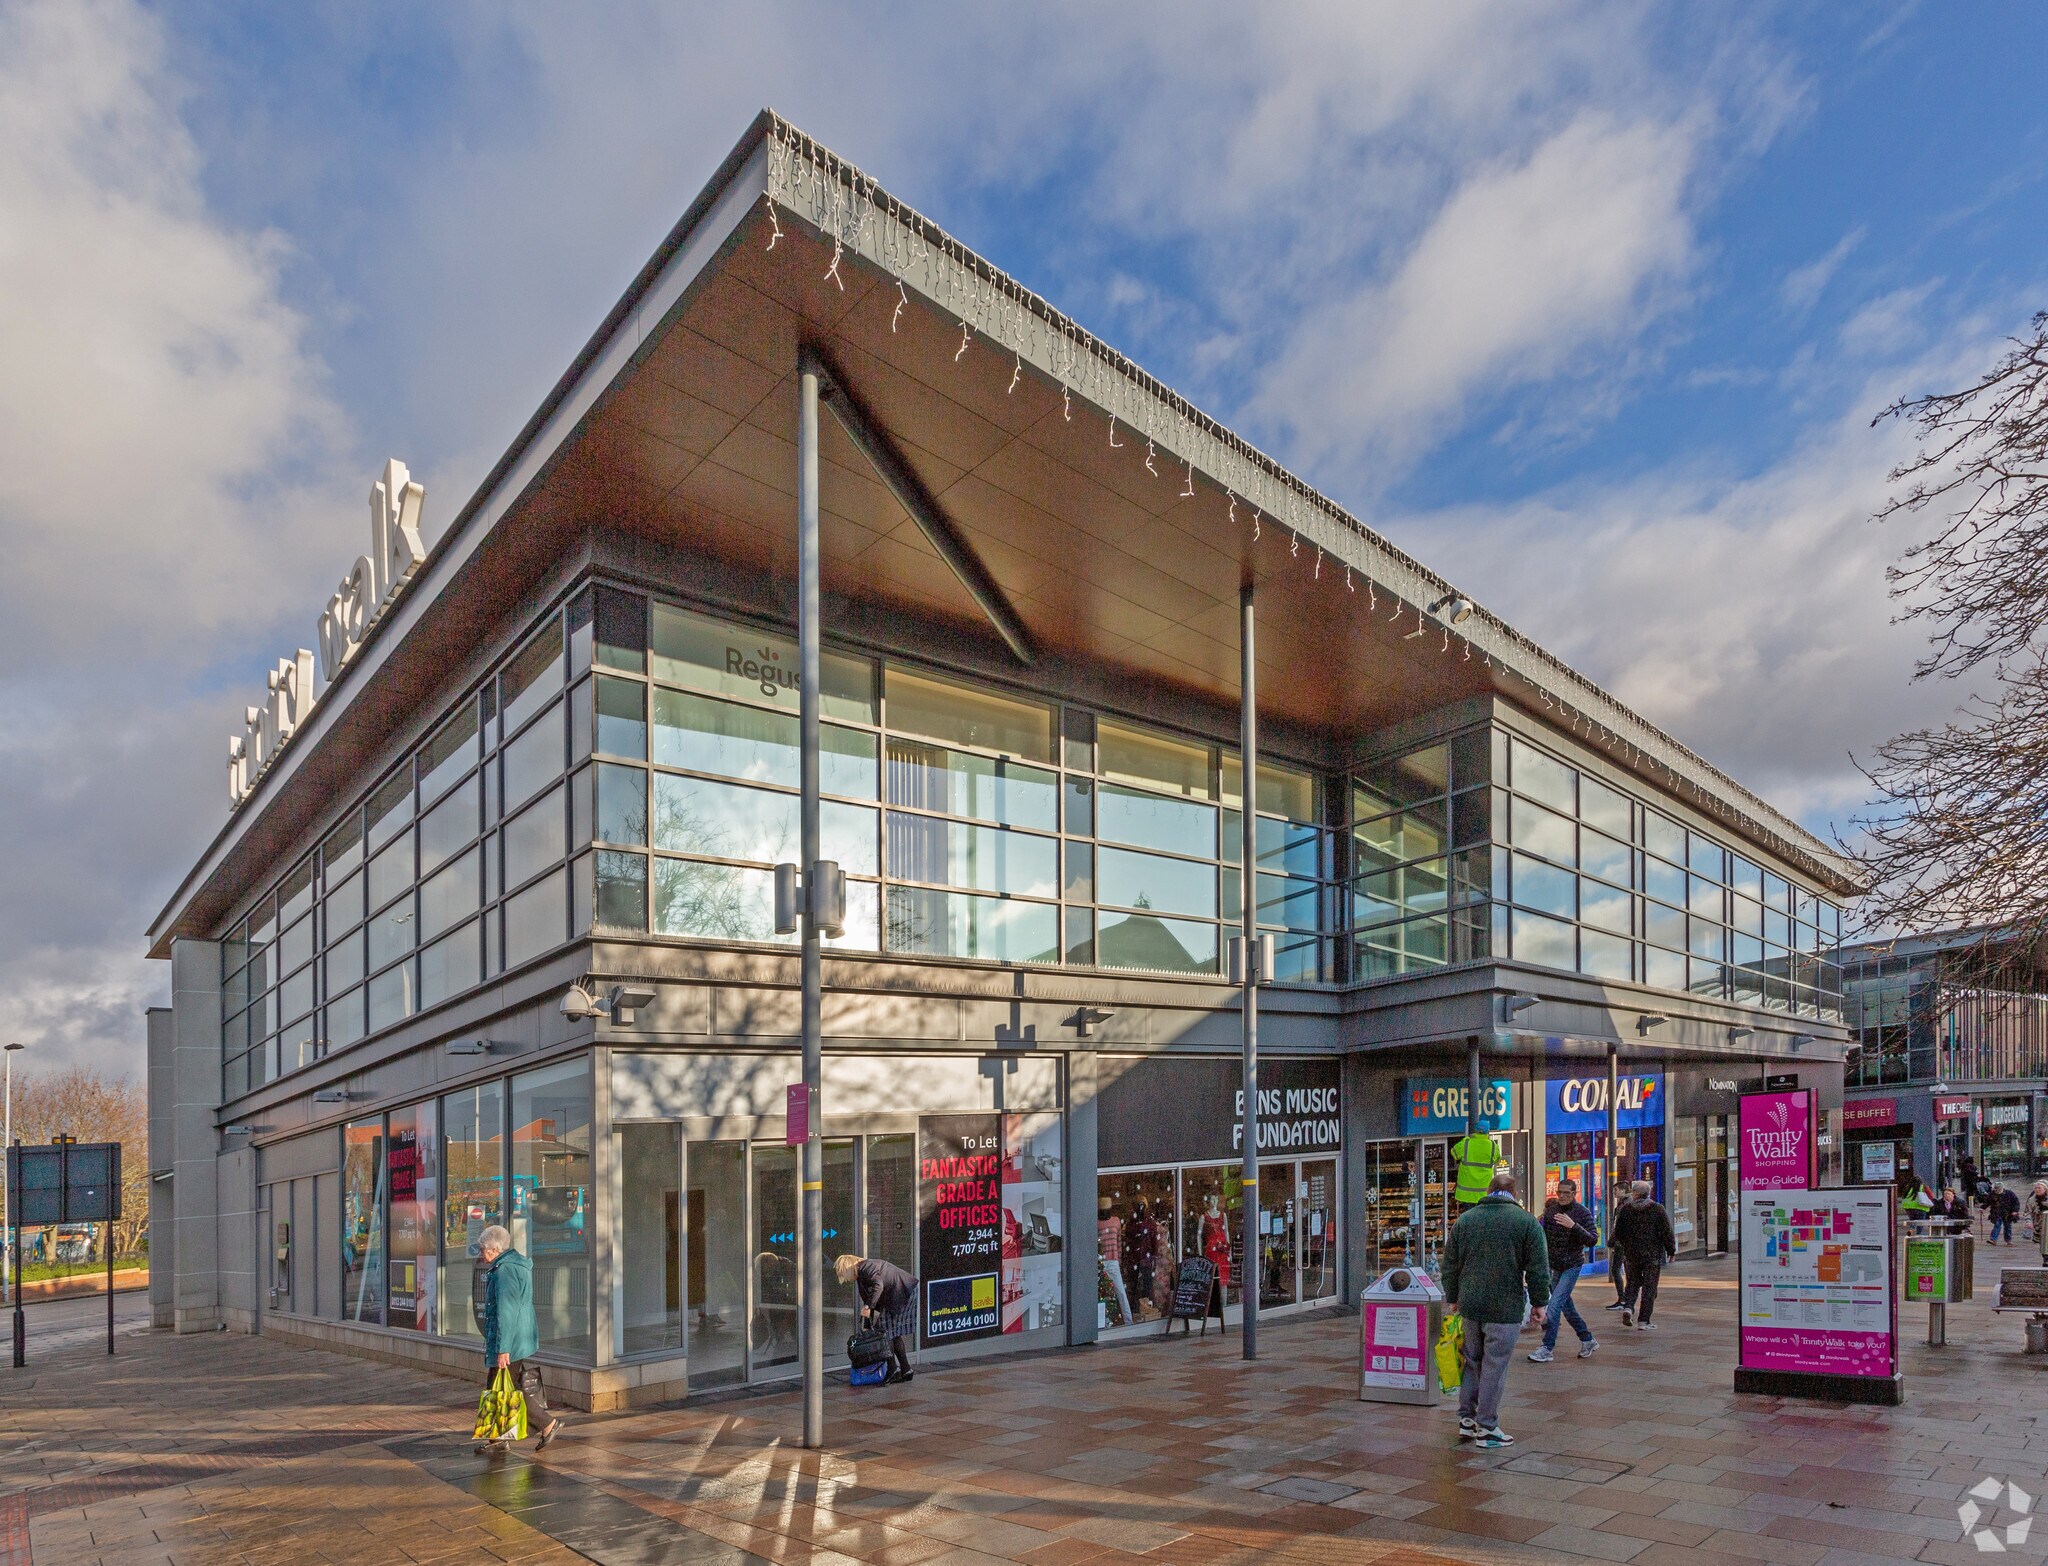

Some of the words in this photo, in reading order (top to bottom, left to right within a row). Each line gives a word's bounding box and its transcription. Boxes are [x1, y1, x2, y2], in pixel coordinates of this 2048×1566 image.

[726, 647, 800, 697] Regus
[1235, 1089, 1281, 1116] BNS
[1286, 1088, 1337, 1114] MUSIC
[1857, 1108, 1891, 1119] BUFFET
[1992, 1106, 2015, 1126] BURGER
[2015, 1105, 2029, 1122] KING
[401, 1130, 407, 1142] To
[961, 1136, 976, 1150] To
[979, 1135, 998, 1148] Let
[1232, 1119, 1340, 1150] FUNDATION
[1746, 1128, 1803, 1146] Trinity
[1751, 1141, 1798, 1159] Walk
[921, 1155, 998, 1180] FANTASTIC
[1755, 1160, 1797, 1168] SHOPPING
[1744, 1176, 1769, 1187] Map
[1771, 1175, 1805, 1185] Guide
[936, 1180, 985, 1205] GRADE
[988, 1179, 998, 1200] A
[940, 1204, 998, 1229] OFFICES
[968, 1228, 993, 1241] 2,944
[952, 1243, 977, 1257] 7,707
[977, 1244, 989, 1255] sq
[990, 1240, 998, 1251] ft
[931, 1305, 968, 1317] savills.co.uk
[973, 1296, 994, 1308] savills
[931, 1319, 954, 1333] 0113
[955, 1316, 972, 1329] 244
[973, 1312, 995, 1326] 0100
